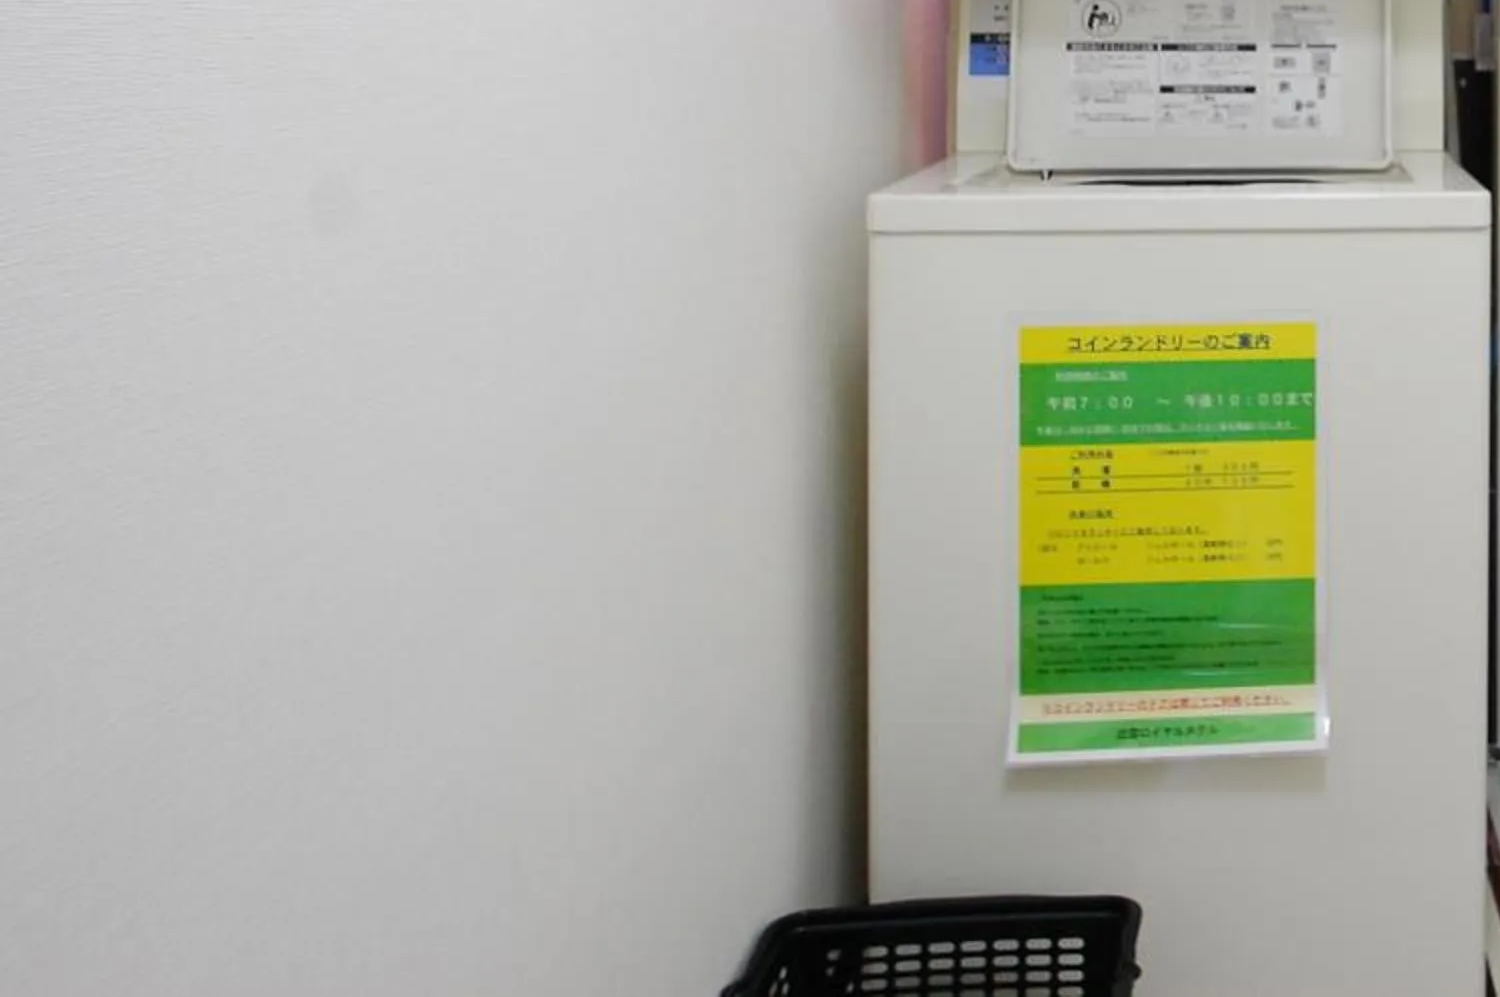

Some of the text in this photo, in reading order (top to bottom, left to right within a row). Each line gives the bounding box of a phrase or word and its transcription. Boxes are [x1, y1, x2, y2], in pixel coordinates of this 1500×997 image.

[1068, 333, 1270, 353] コインランドリーのご案内
